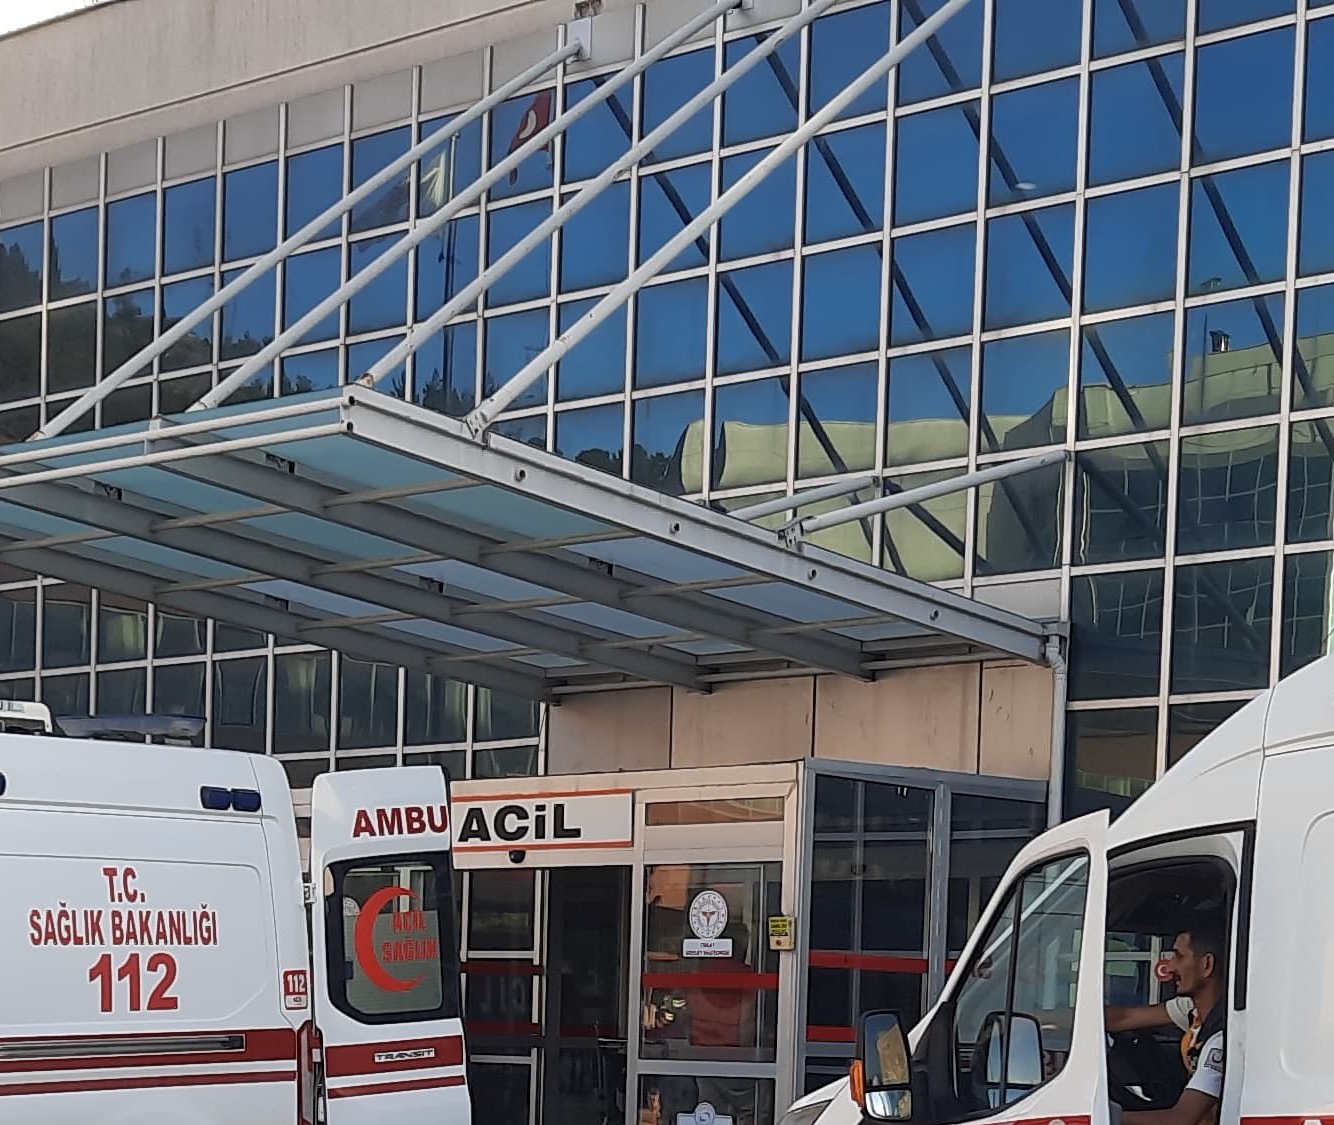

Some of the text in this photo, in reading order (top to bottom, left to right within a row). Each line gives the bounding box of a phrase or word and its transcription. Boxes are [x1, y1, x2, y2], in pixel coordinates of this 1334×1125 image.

[352, 805, 448, 838] AMBU
[102, 867, 146, 903] T.C.
[29, 901, 218, 946] SAĞLIK BAKANLIĞI
[89, 952, 179, 1013] 112
[287, 974, 306, 993] 112
